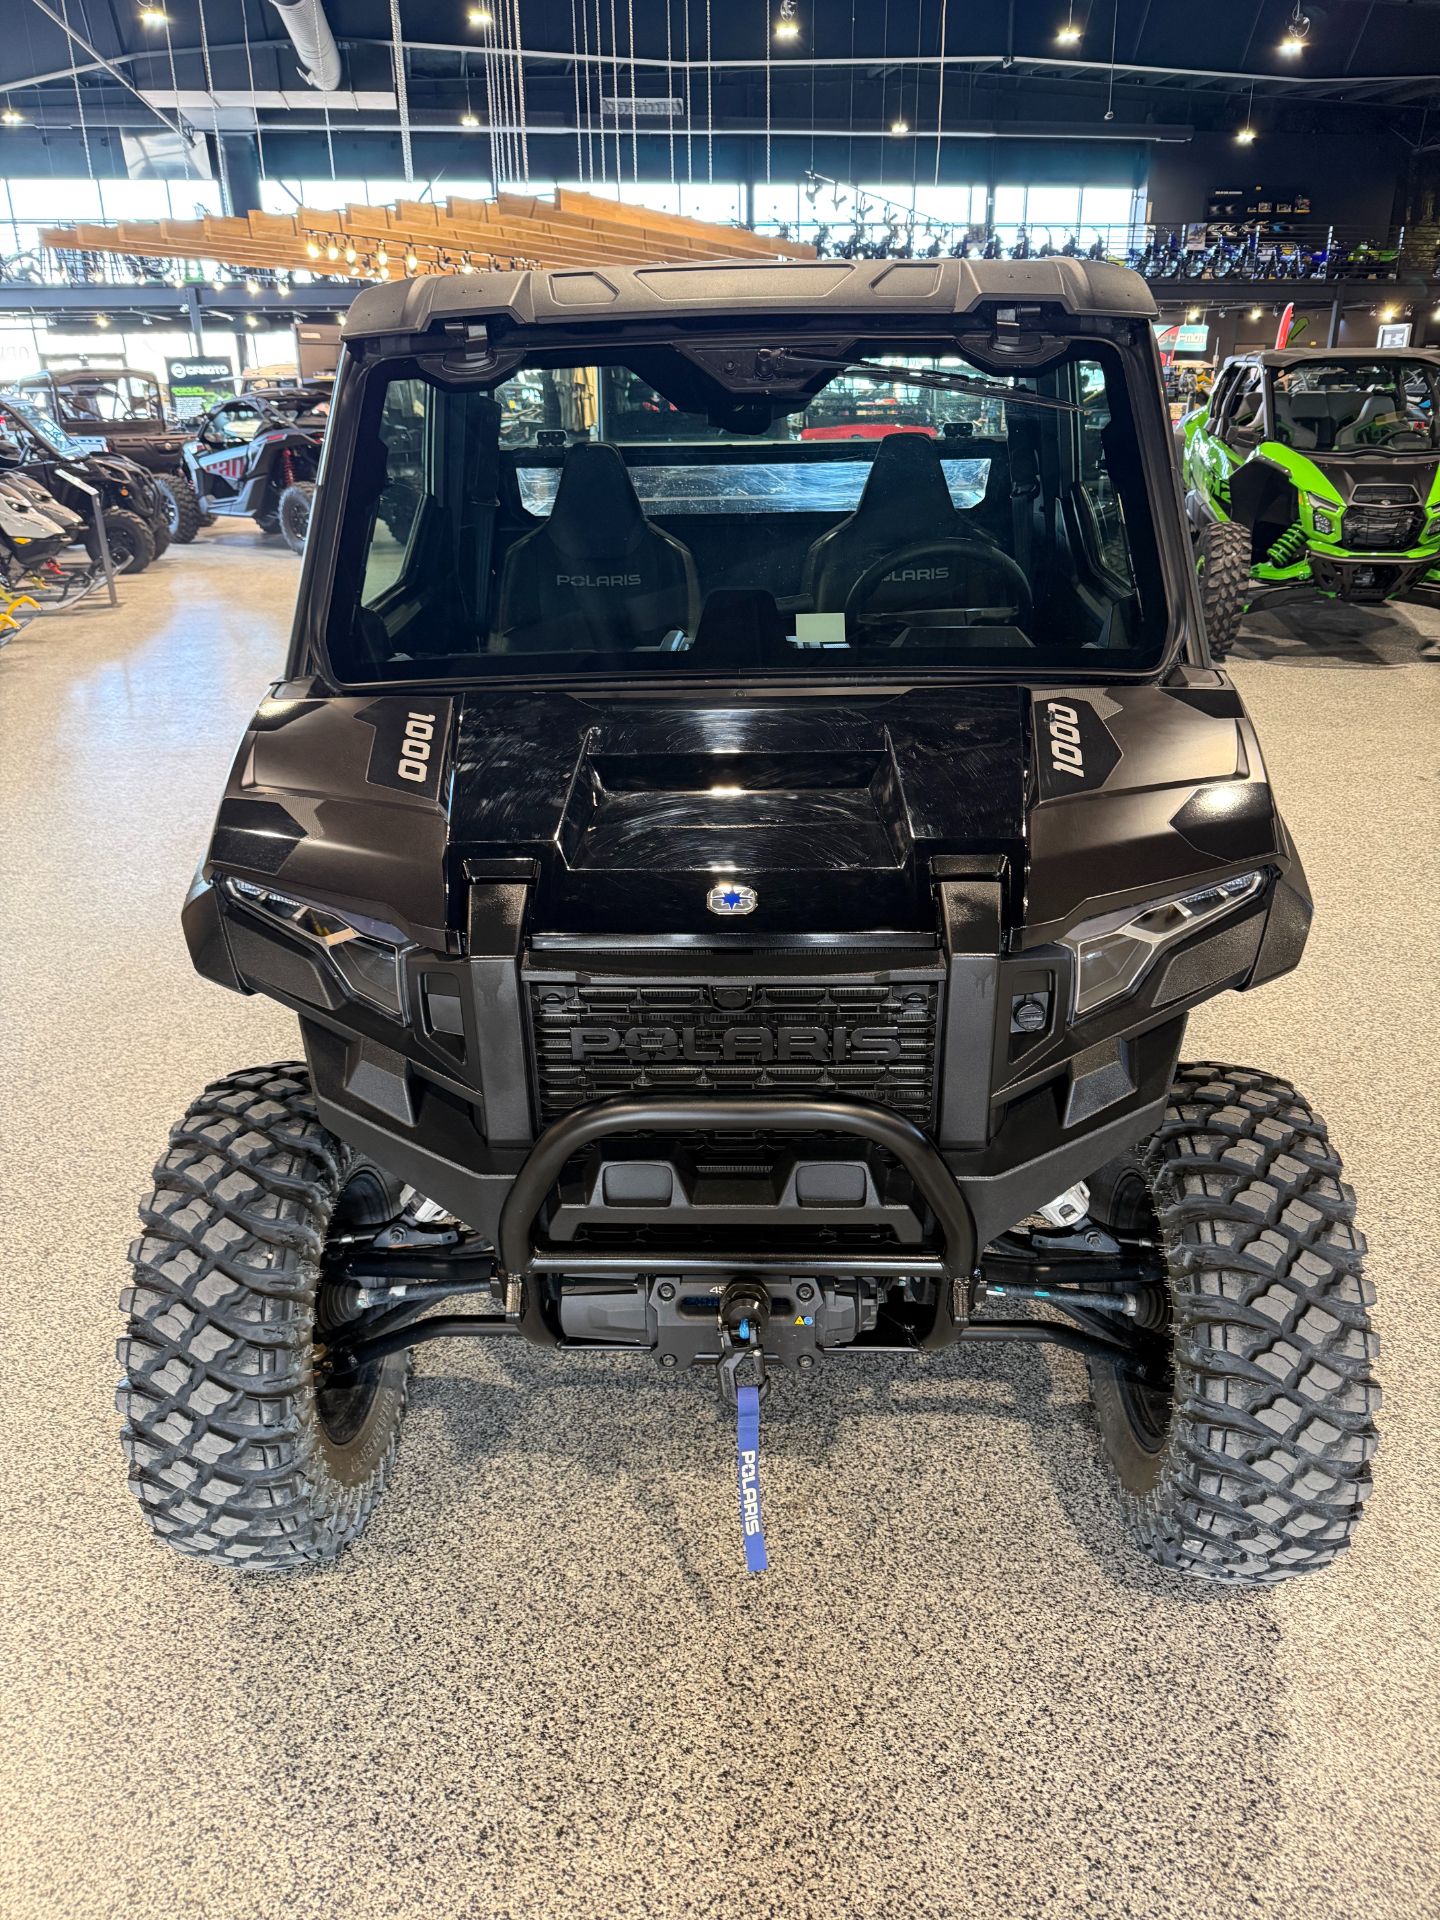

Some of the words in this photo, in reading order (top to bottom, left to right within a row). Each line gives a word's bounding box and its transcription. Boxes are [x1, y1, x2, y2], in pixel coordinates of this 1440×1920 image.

[556, 574, 642, 587] POLARIS
[880, 567, 950, 582] LARIS
[397, 711, 436, 783] 1000
[1047, 702, 1085, 778] 1000
[570, 1026, 902, 1062] POLARIS
[741, 1450, 760, 1536] POLARIS
